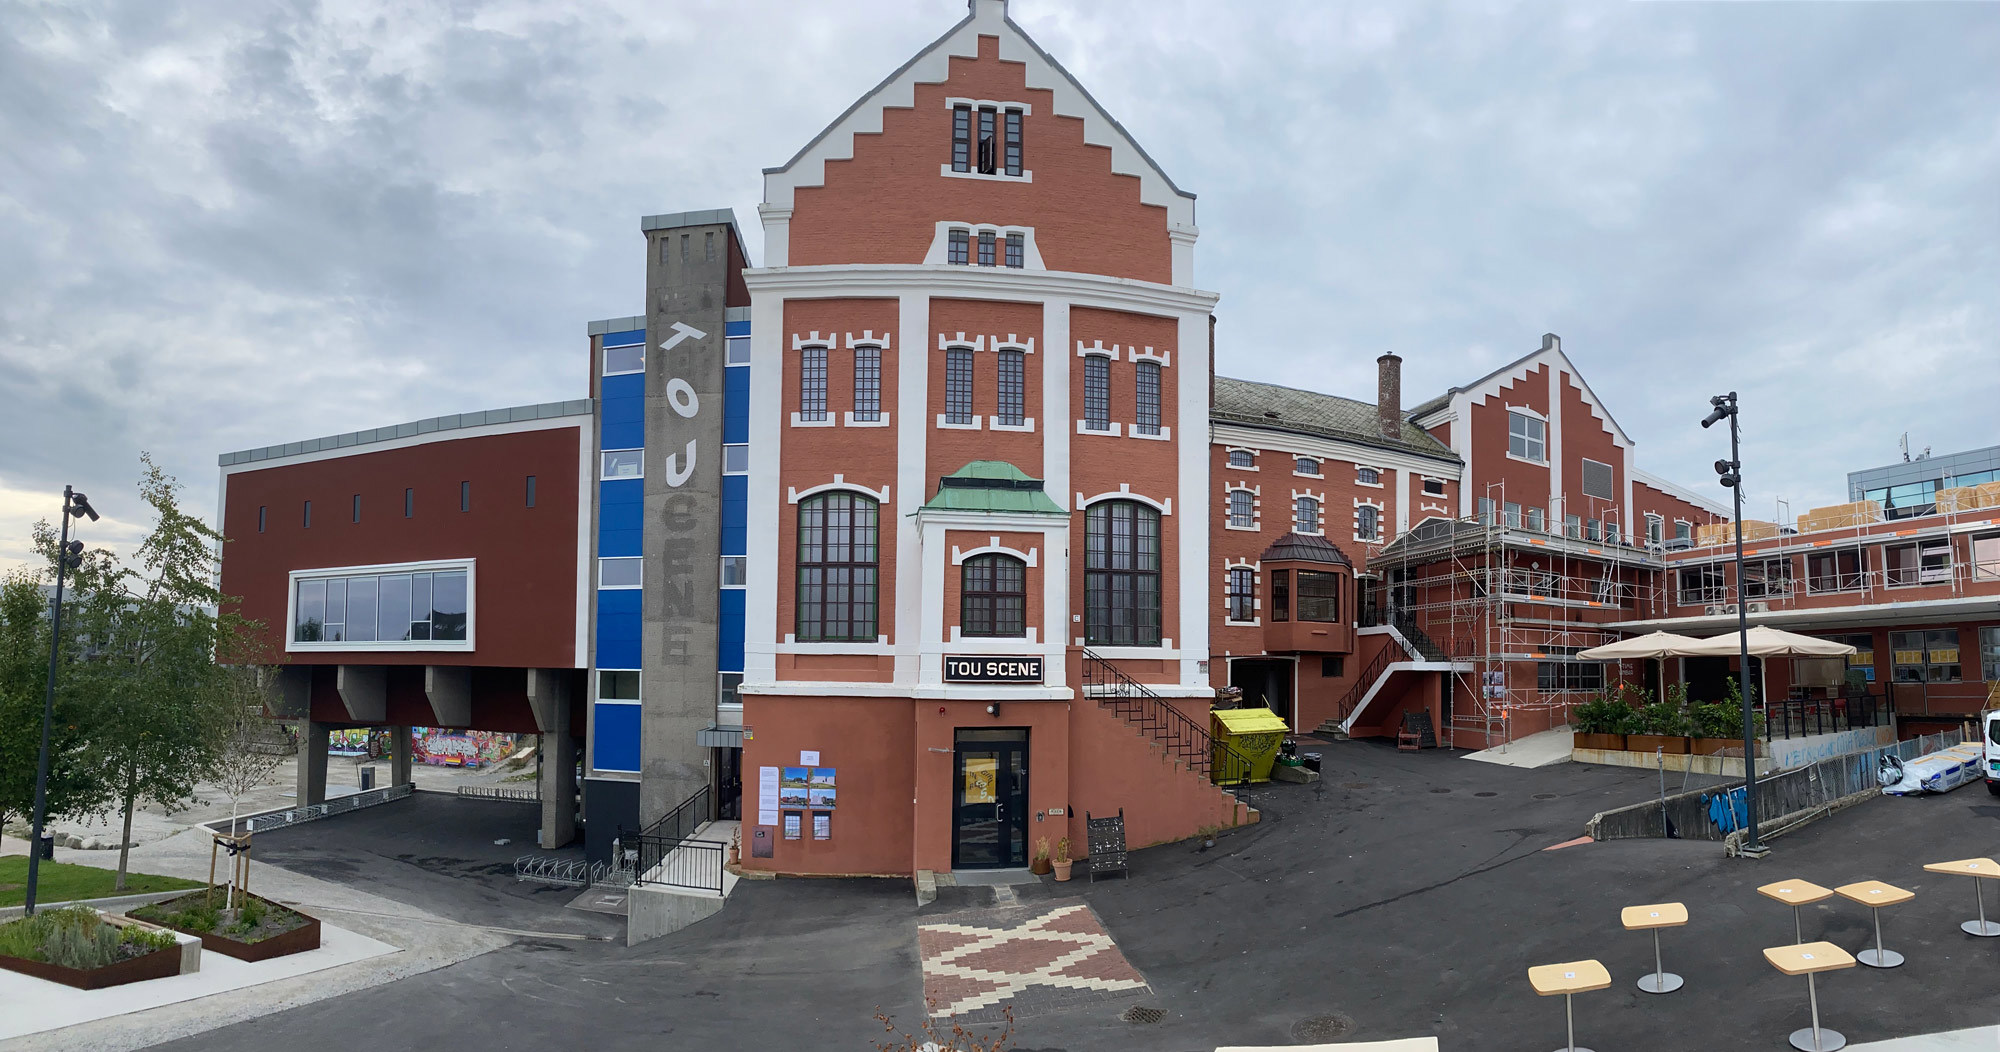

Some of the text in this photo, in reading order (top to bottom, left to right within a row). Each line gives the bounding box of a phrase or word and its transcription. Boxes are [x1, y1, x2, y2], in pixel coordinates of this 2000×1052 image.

[659, 321, 707, 488] TOU
[948, 661, 1039, 676] TOU SCENE
